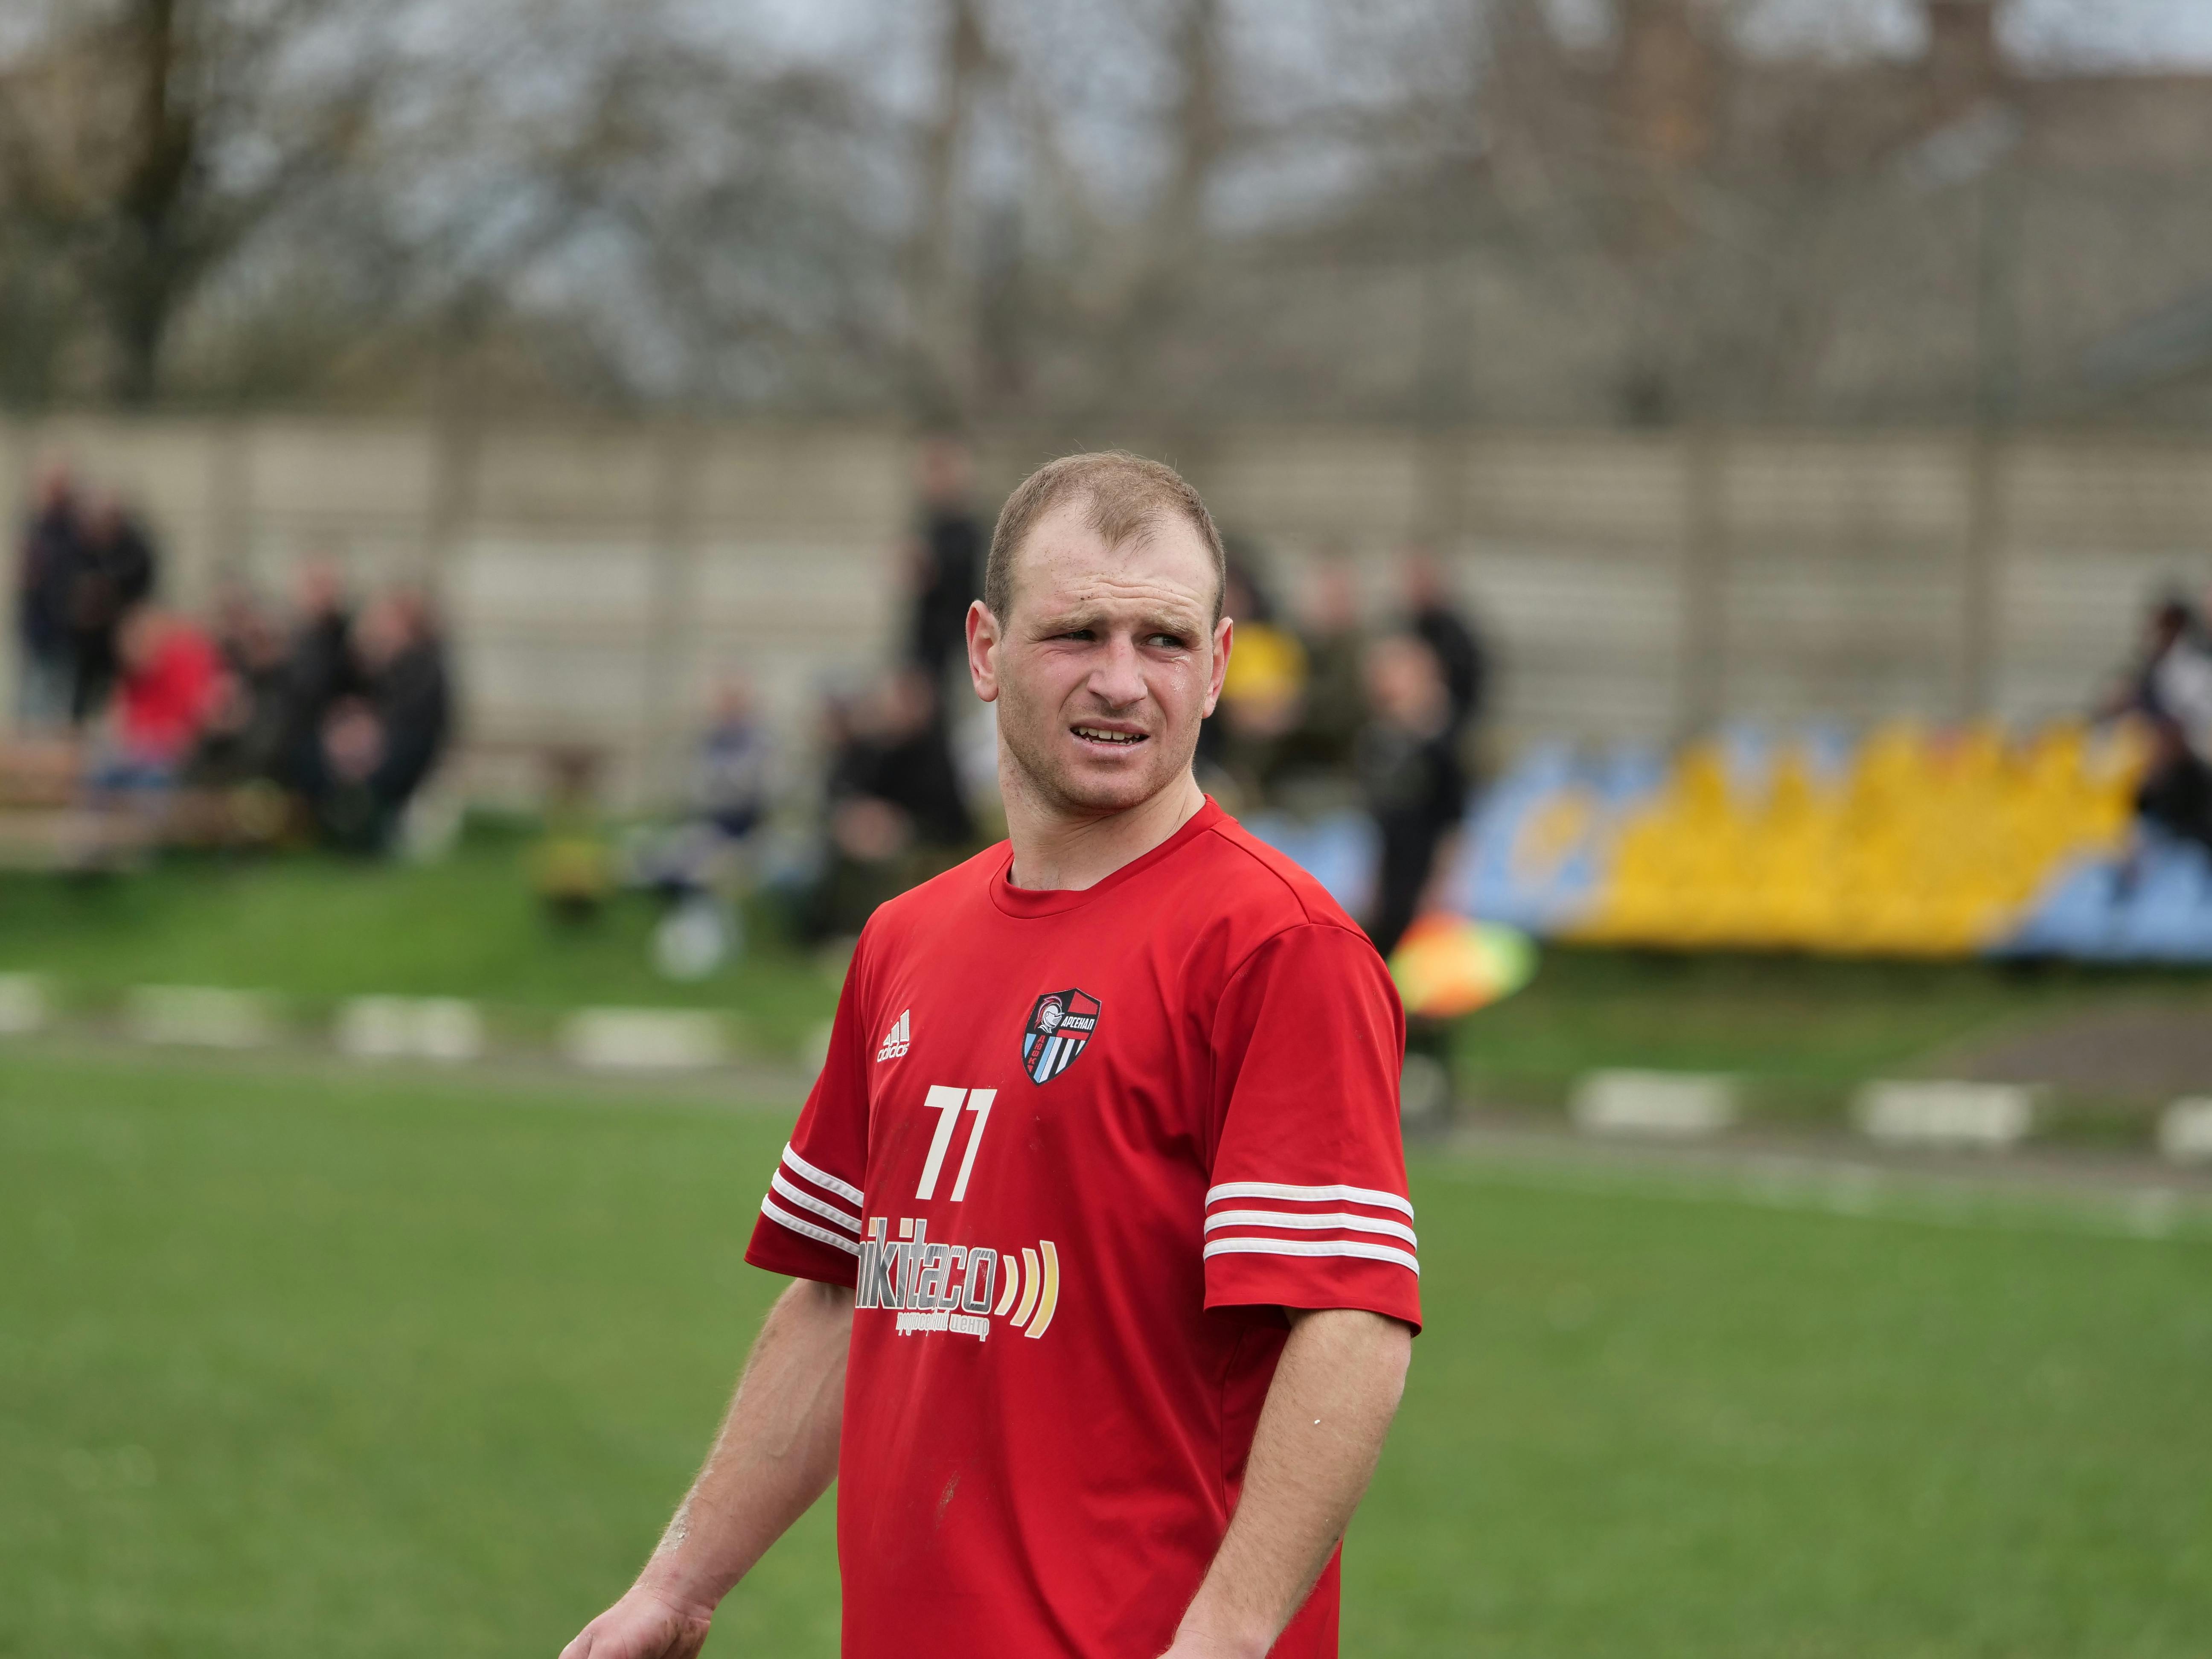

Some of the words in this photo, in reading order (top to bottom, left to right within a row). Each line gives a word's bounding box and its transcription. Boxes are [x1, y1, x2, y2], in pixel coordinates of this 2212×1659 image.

[1060, 1016, 1095, 1030] АРСЕНАЛ
[877, 1041, 910, 1062] adidas
[949, 1313, 990, 1342] центр
